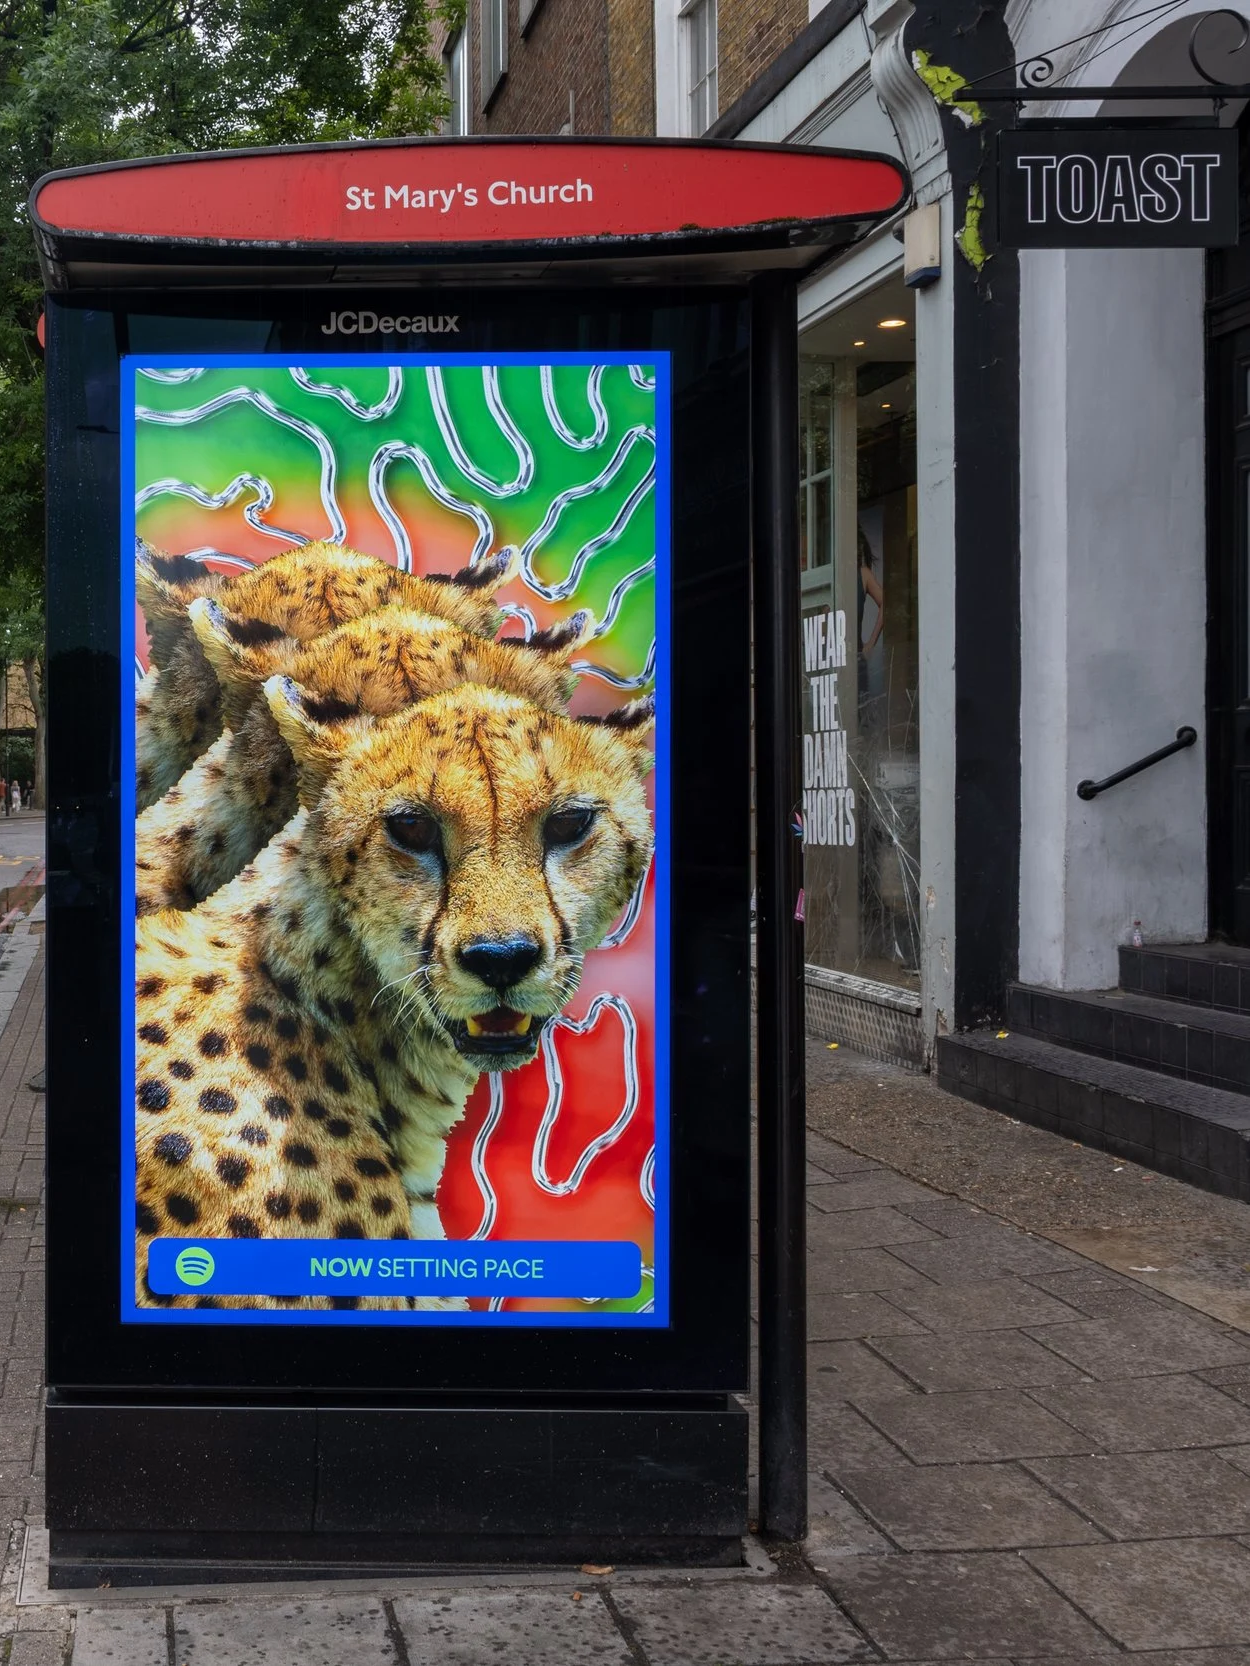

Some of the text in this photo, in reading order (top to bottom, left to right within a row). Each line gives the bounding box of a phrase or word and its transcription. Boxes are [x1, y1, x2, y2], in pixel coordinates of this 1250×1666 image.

[346, 178, 593, 213] St Mary's Church
[1017, 154, 1220, 223] TOAST
[321, 311, 460, 335] JCDecaux
[803, 610, 846, 672] WEAR
[810, 673, 839, 732] THE
[803, 730, 848, 789] DAMN
[310, 1257, 544, 1279] NOW SETTING PACE
